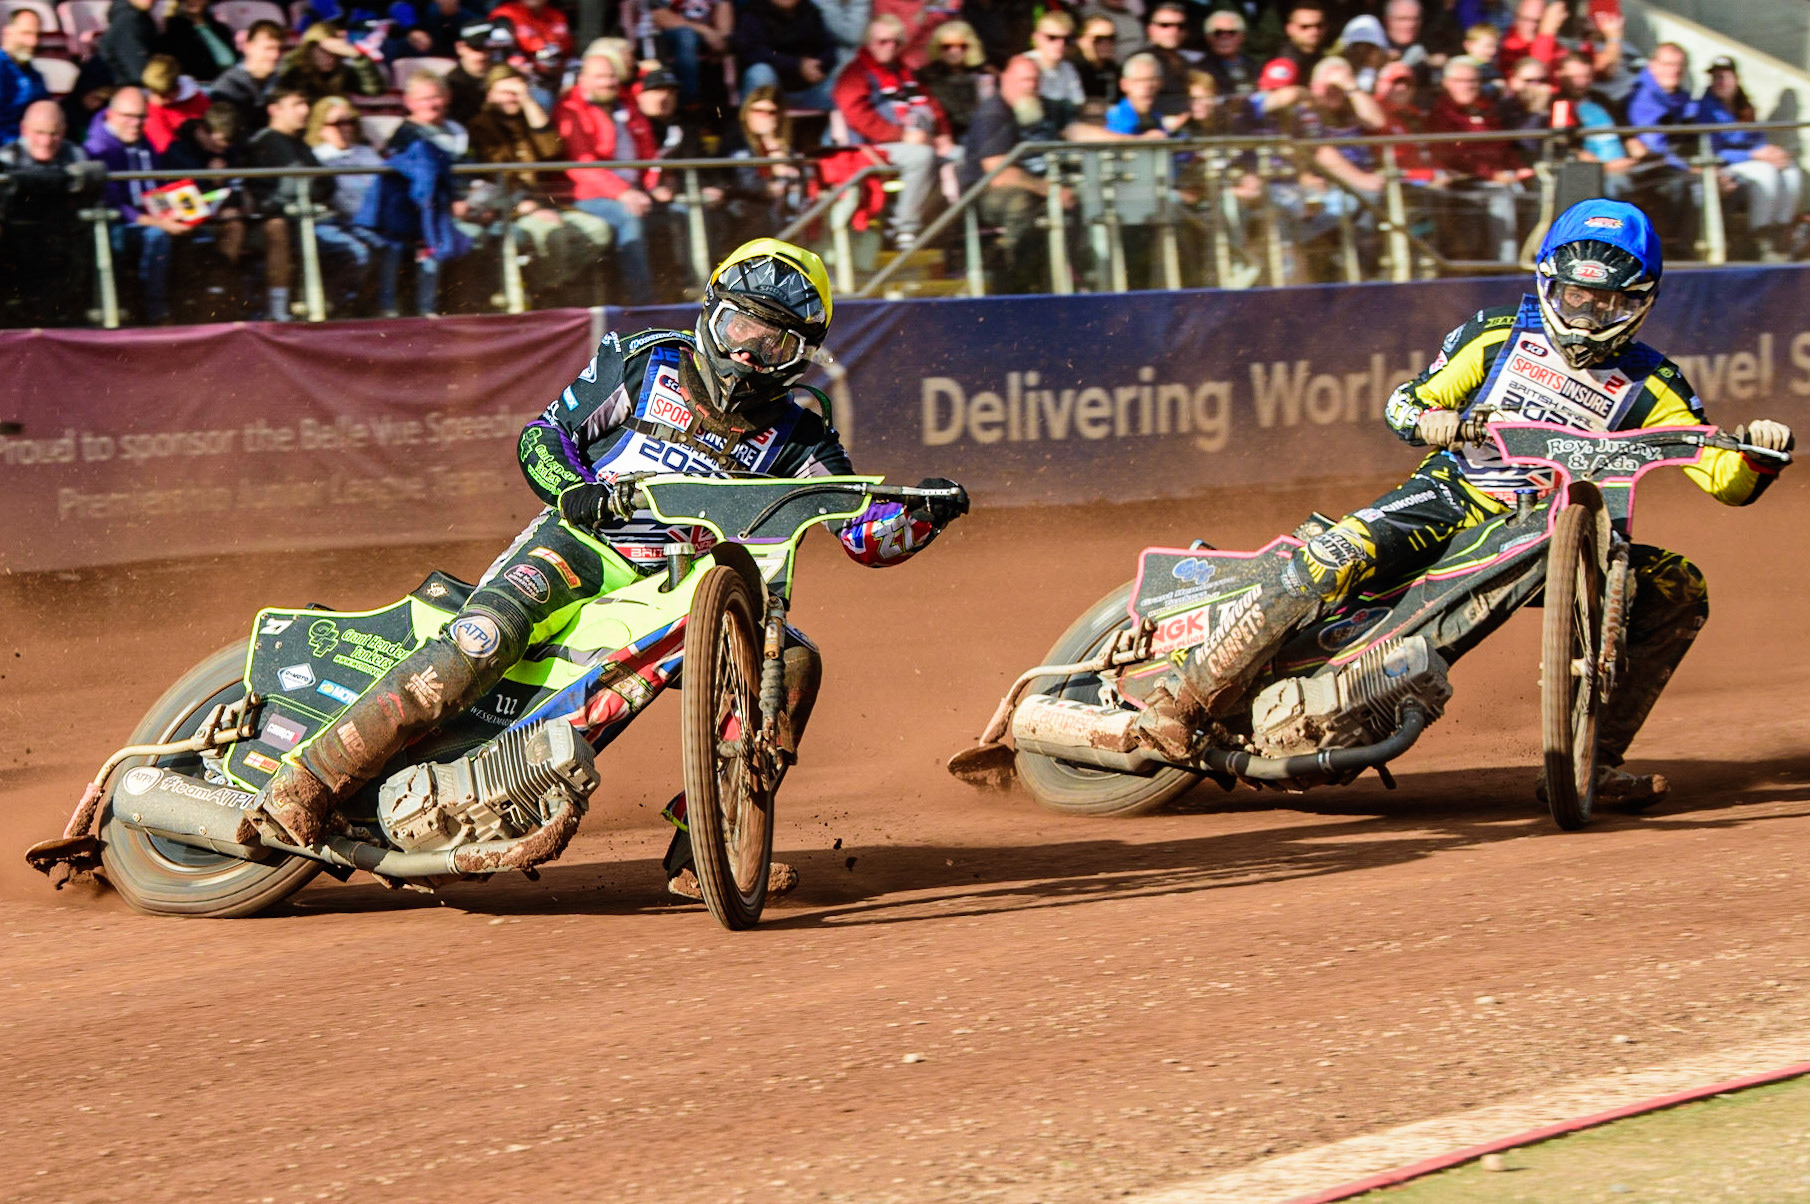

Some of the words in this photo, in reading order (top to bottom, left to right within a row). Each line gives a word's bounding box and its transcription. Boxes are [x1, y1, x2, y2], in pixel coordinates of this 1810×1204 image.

[921, 368, 1233, 452] Delivering
[1249, 350, 1426, 428] World
[1508, 380, 1561, 409] BRITISH
[1512, 357, 1565, 390] SPORTS
[1561, 378, 1612, 418] INSURE
[653, 398, 693, 429] SPOR
[81, 431, 116, 463] to
[119, 429, 238, 467] sponsor
[243, 418, 294, 452] the
[1380, 489, 1437, 513] Silkolene
[630, 548, 665, 558] BRIT
[341, 628, 369, 647] Grant
[459, 621, 492, 651] ATPI
[1152, 609, 1205, 643] NGK
[1206, 602, 1266, 677] CARPETS
[350, 645, 395, 669] Tankers
[132, 772, 155, 784] ATPI
[160, 774, 256, 810] #teamATPI
